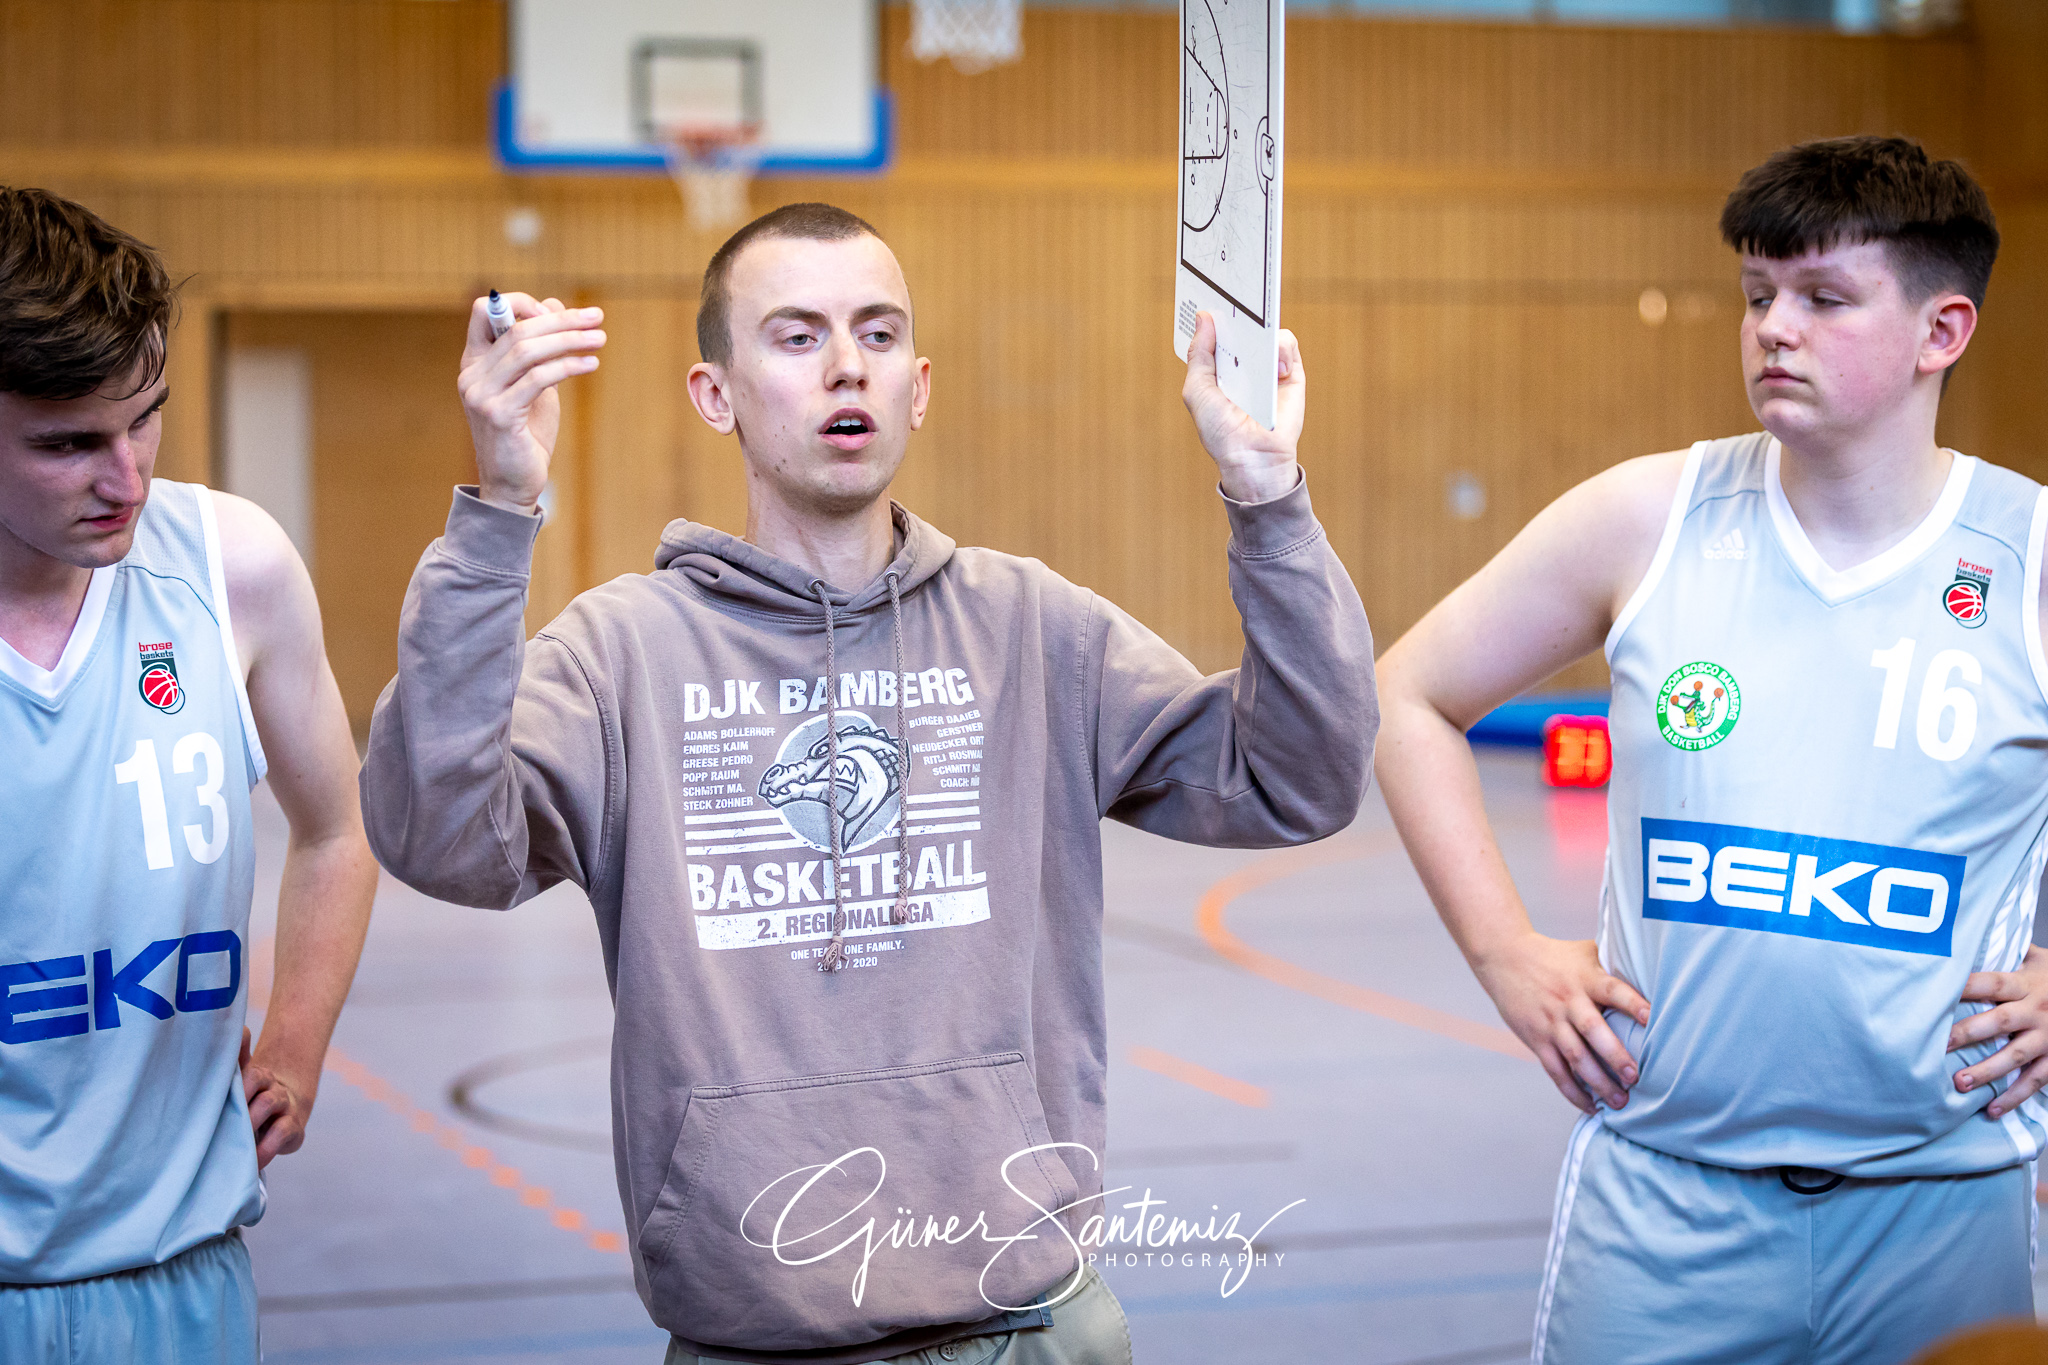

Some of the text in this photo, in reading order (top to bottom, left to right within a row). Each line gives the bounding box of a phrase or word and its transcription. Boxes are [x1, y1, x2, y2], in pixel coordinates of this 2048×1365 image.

[1958, 557, 1993, 576] brose
[138, 641, 173, 652] brose
[139, 650, 174, 660] baskets
[683, 667, 975, 723] DJK BAMBERG
[1658, 663, 1740, 721] DJK DON BOSCO BAMBERG
[1870, 637, 1982, 762] 16
[908, 715, 945, 729] BURGER
[936, 721, 984, 738] GERSTNER
[683, 727, 776, 741] ADAMS BOLLERHOFF
[1662, 725, 1725, 750] BASKETBALL
[683, 741, 749, 755] ENDRES KAIM
[912, 737, 968, 754] NEUDECKER
[682, 754, 754, 769] GREESE PEDRO
[932, 763, 971, 776] SCHMITT
[682, 769, 740, 783] POPP RAUM
[682, 783, 746, 797] SCHMITT MA.
[114, 731, 230, 871] 13
[683, 796, 754, 811] STECK ZOHNER
[687, 839, 987, 911] BASKETBALL
[1648, 838, 1950, 934] BEKO
[757, 901, 934, 939] 2. REGINALLGA
[791, 949, 810, 960] ONE
[844, 943, 864, 955] ONE
[866, 940, 905, 953] FAMILY.
[852, 956, 878, 968] 2020
